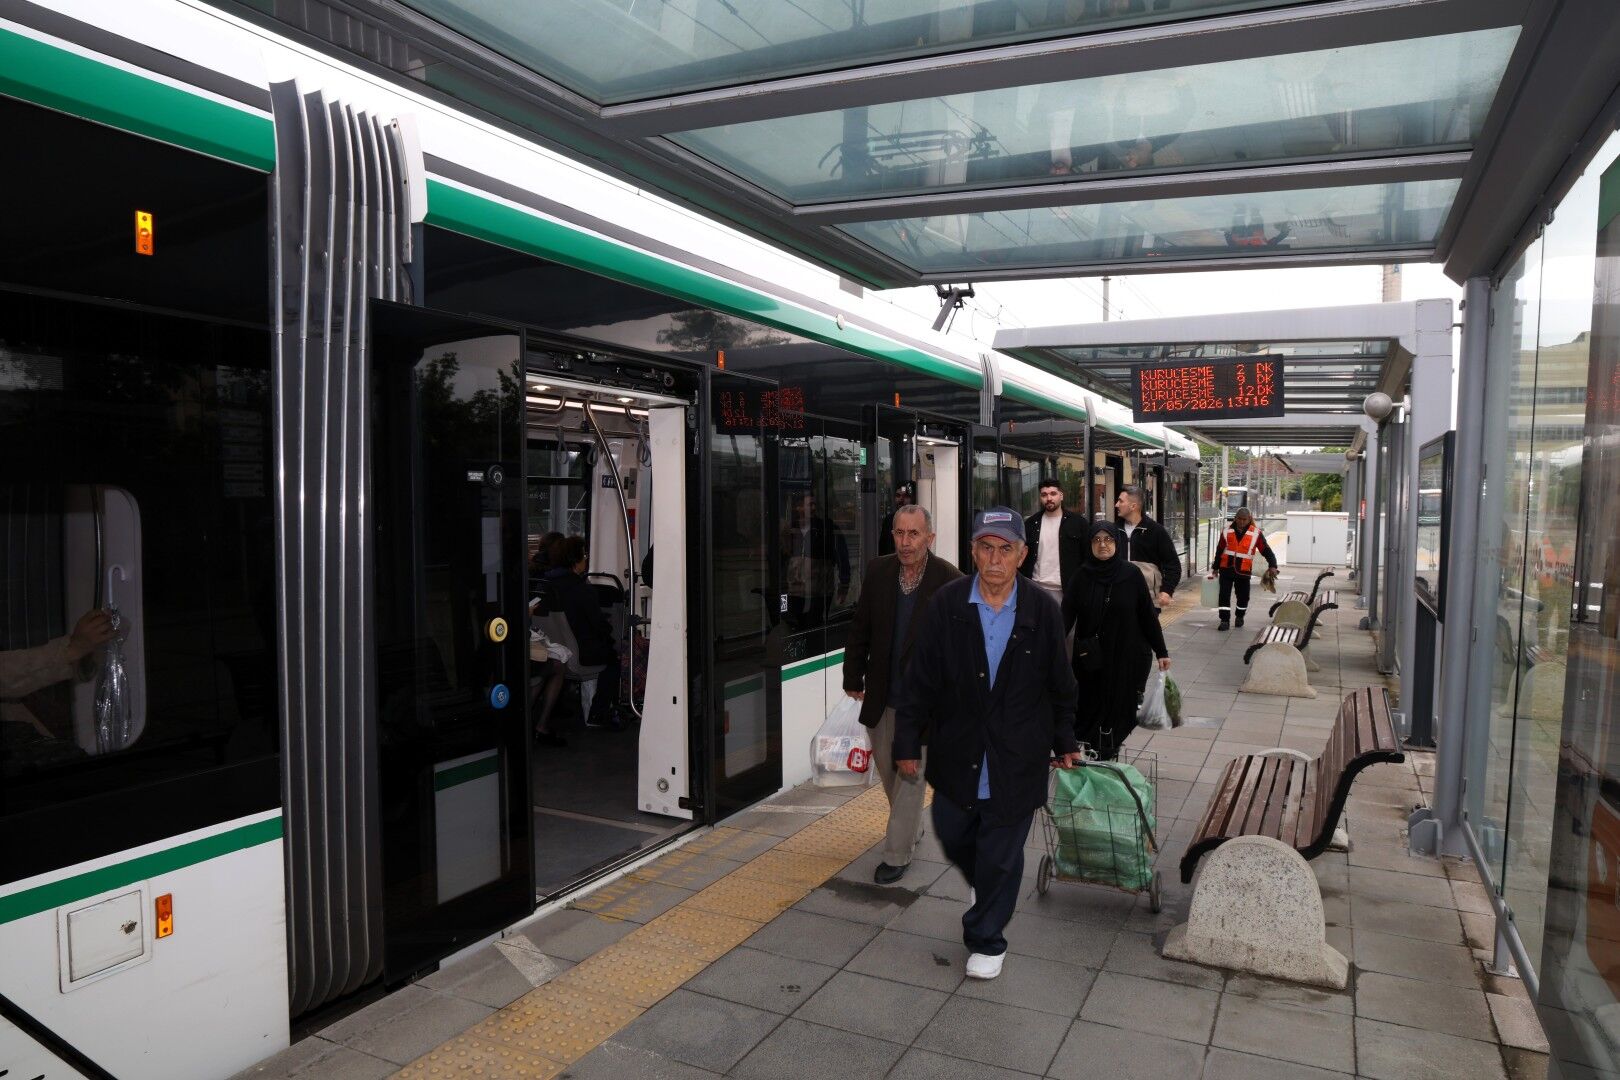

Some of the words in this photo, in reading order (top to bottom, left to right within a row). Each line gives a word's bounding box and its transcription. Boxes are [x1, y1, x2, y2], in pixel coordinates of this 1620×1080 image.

[1140, 366, 1214, 381] KURUCESME
[1236, 364, 1245, 375] 2
[1256, 362, 1274, 373] DK
[1141, 377, 1215, 391] KURUCESME
[1236, 374, 1246, 386] 9
[1256, 373, 1274, 384] DK
[1141, 387, 1215, 402] KURUCESME
[1238, 386, 1254, 396] 12
[1257, 384, 1274, 395] DK
[1142, 399, 1224, 412] 21/05/2026
[1228, 397, 1269, 408] 13:16
